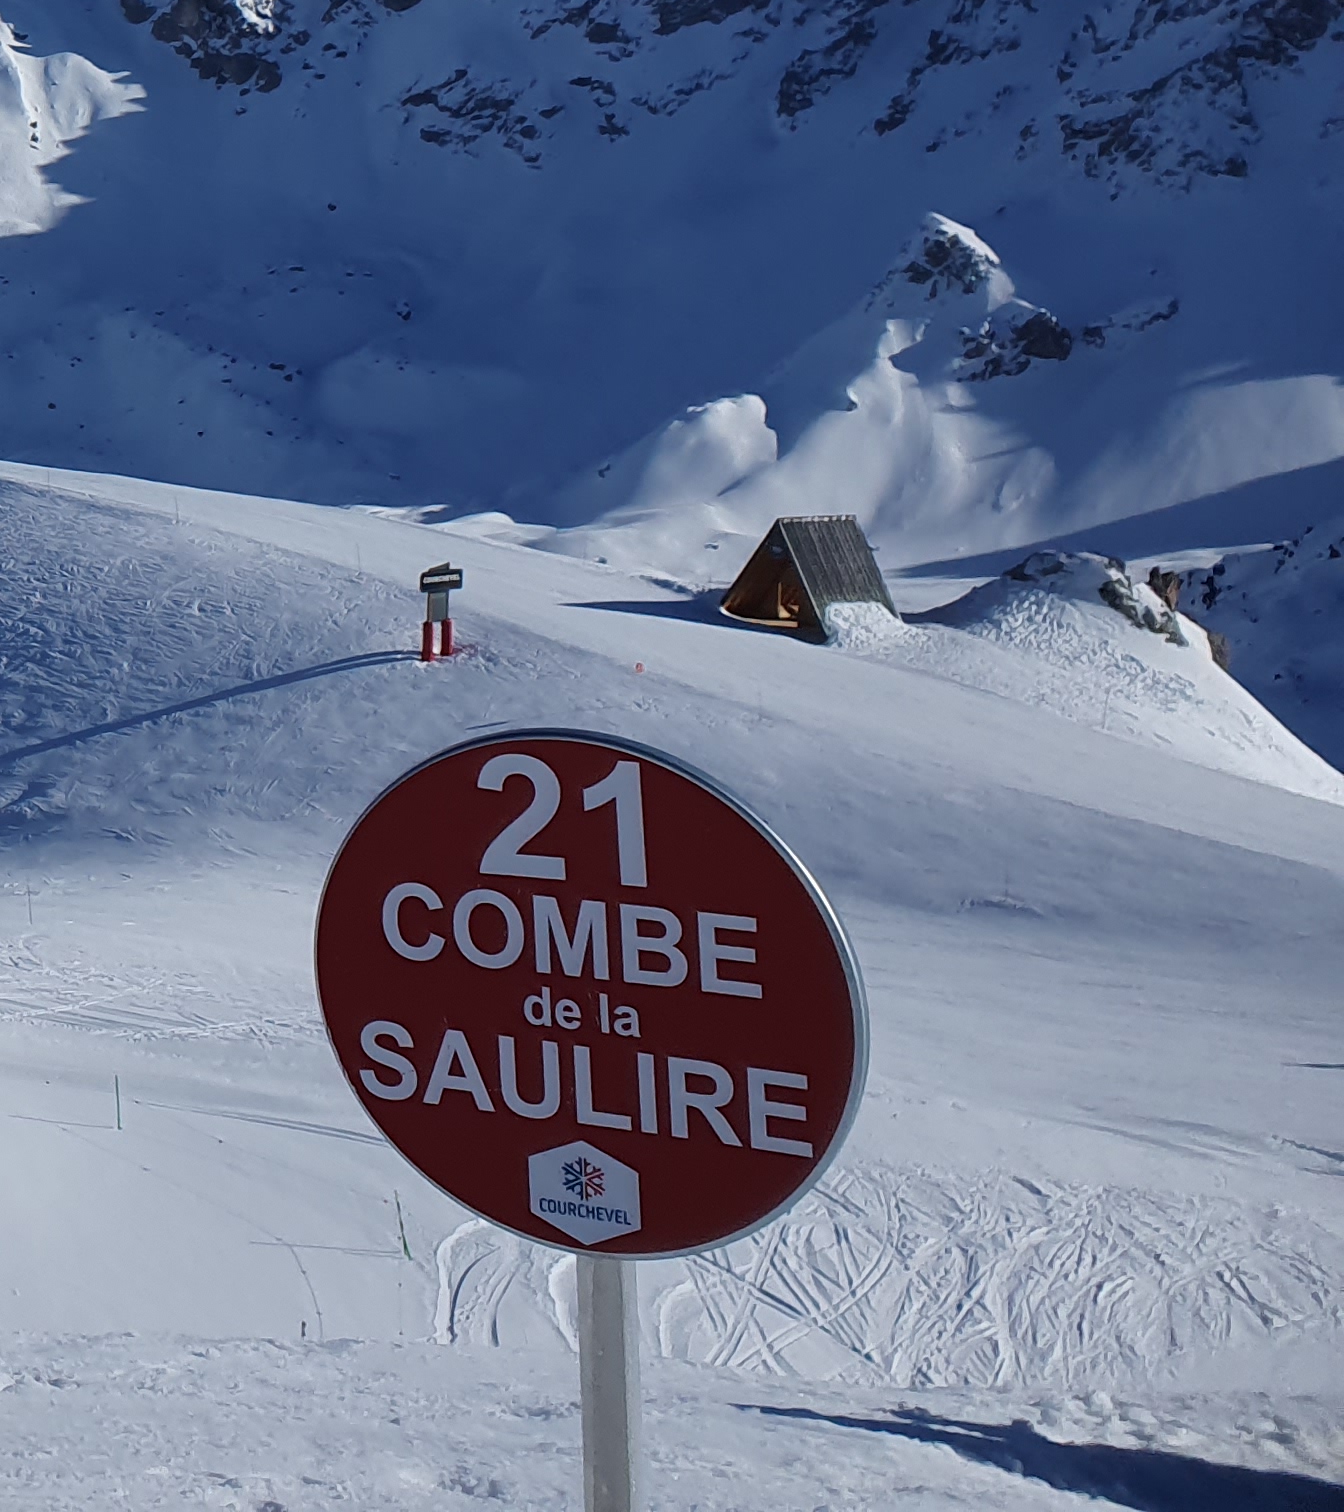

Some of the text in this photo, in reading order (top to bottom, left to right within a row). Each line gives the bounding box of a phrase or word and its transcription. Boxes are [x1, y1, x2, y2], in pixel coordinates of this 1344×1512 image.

[477, 753, 648, 888] 21
[382, 882, 763, 999] COMBE
[523, 986, 642, 1038] de la
[359, 1020, 814, 1158] SAULIRE
[538, 1197, 633, 1226] COURCHEVEL
